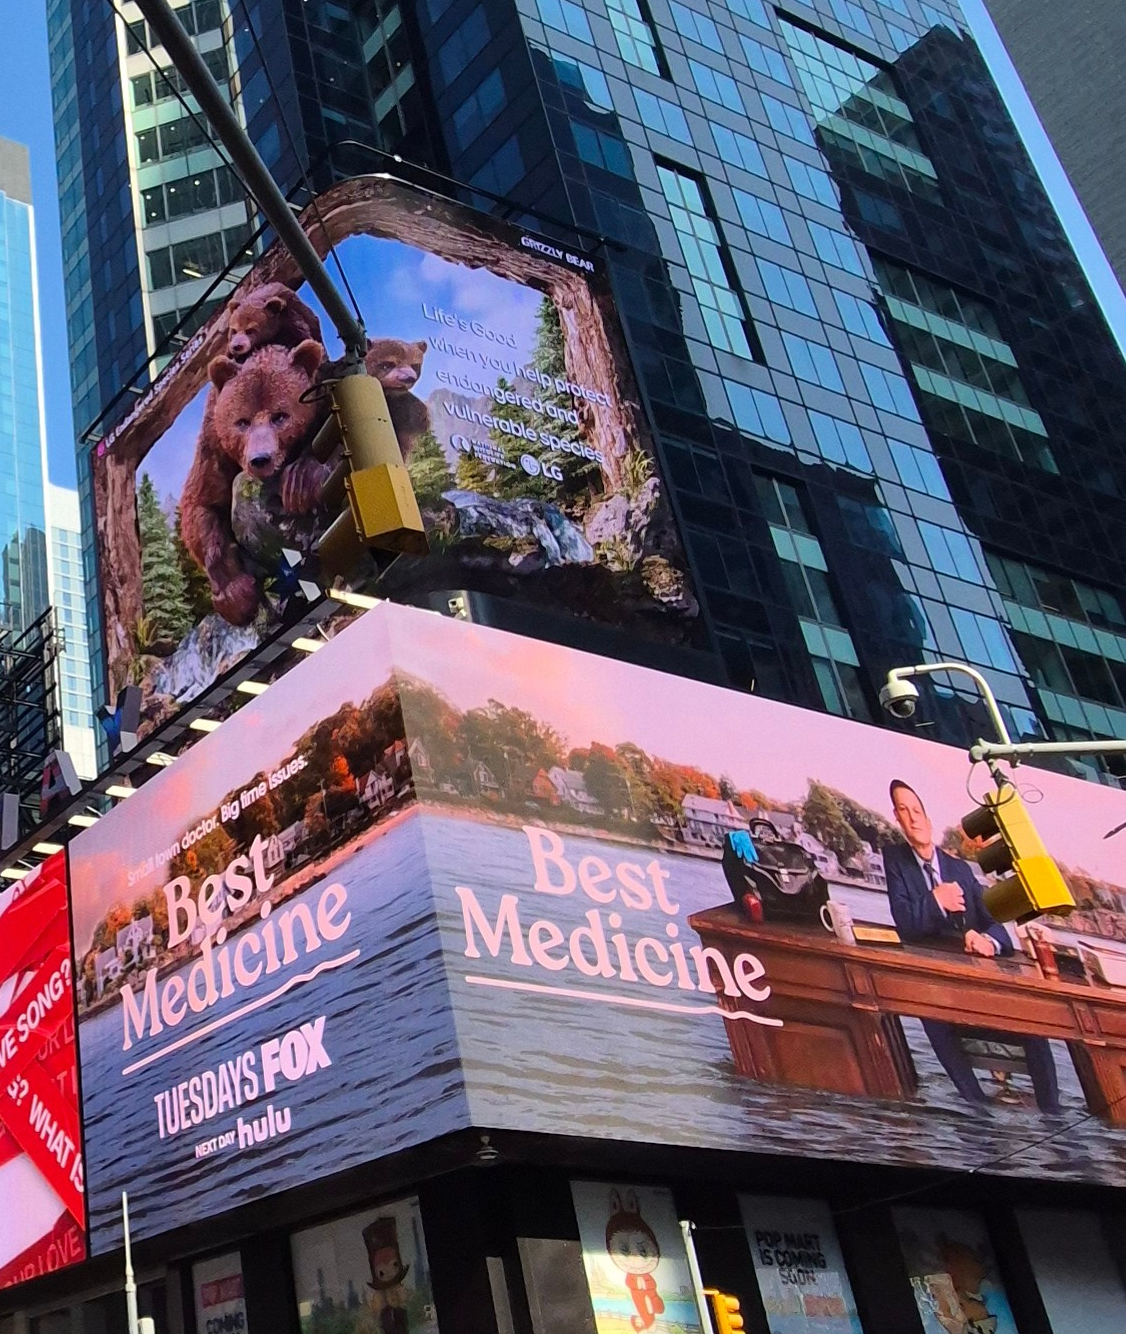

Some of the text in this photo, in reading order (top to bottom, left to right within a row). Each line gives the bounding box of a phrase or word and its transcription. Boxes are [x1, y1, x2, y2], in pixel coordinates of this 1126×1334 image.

[520, 235, 595, 273] GRIZZLY BEAR
[422, 303, 517, 350] Life's Good
[428, 335, 612, 408] when you help protect
[436, 368, 579, 425] endangered and
[443, 401, 605, 464] vulnerable species
[542, 465, 564, 482] LG
[128, 855, 155, 887] Small
[181, 815, 220, 851] doctor.
[221, 799, 242, 822] Big
[240, 784, 267, 811] time
[268, 754, 310, 790] issues.
[163, 834, 275, 949] Best
[523, 825, 680, 916] Best
[121, 883, 352, 1052] Medicine
[455, 886, 771, 1002] Medicine
[16, 957, 71, 1044] SONG?
[154, 1051, 260, 1139] TUESDAYS
[260, 1016, 333, 1093] FOX
[29, 1094, 75, 1169] WHAT
[194, 1104, 291, 1159] NEXT DAY hulu
[758, 1247, 827, 1269] IS COMING
[778, 1266, 818, 1287] SOON
